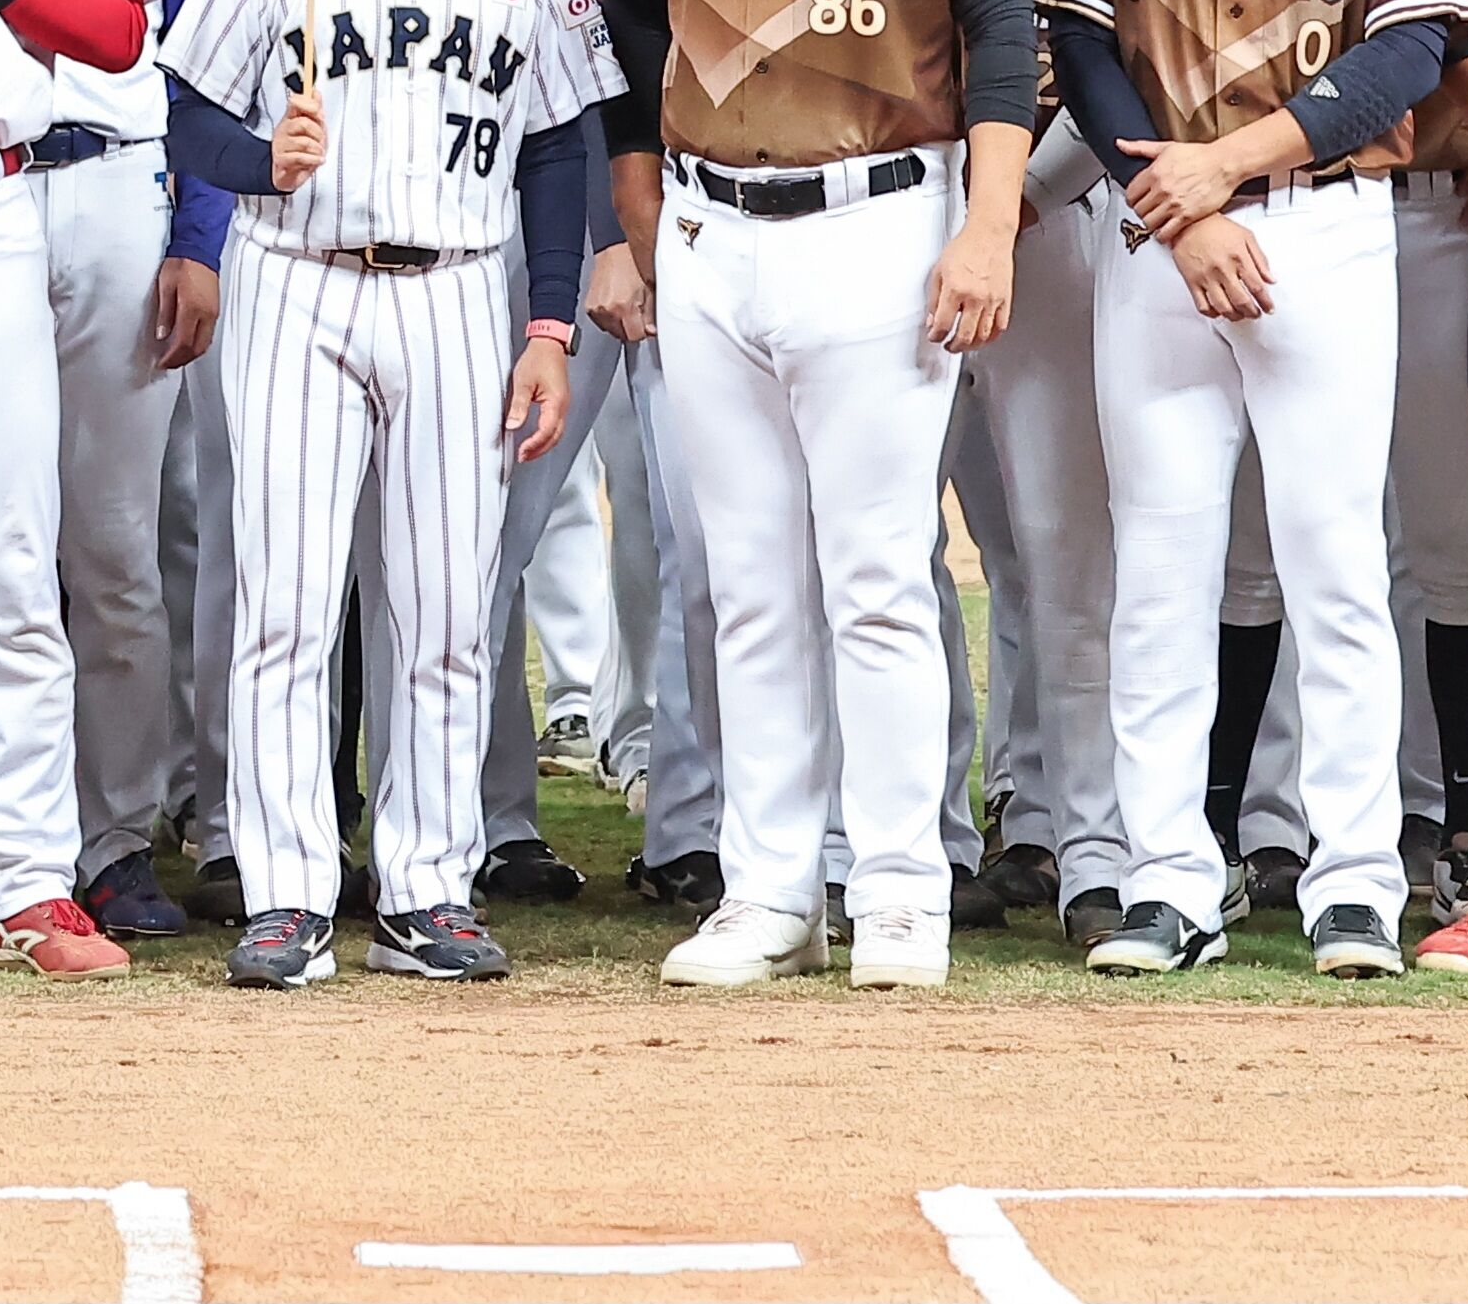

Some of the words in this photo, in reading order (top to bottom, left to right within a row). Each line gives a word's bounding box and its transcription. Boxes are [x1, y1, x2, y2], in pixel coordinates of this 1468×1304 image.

[282, 6, 528, 104] JAPAN
[1295, 18, 1333, 78] 0
[445, 112, 501, 179] 78
